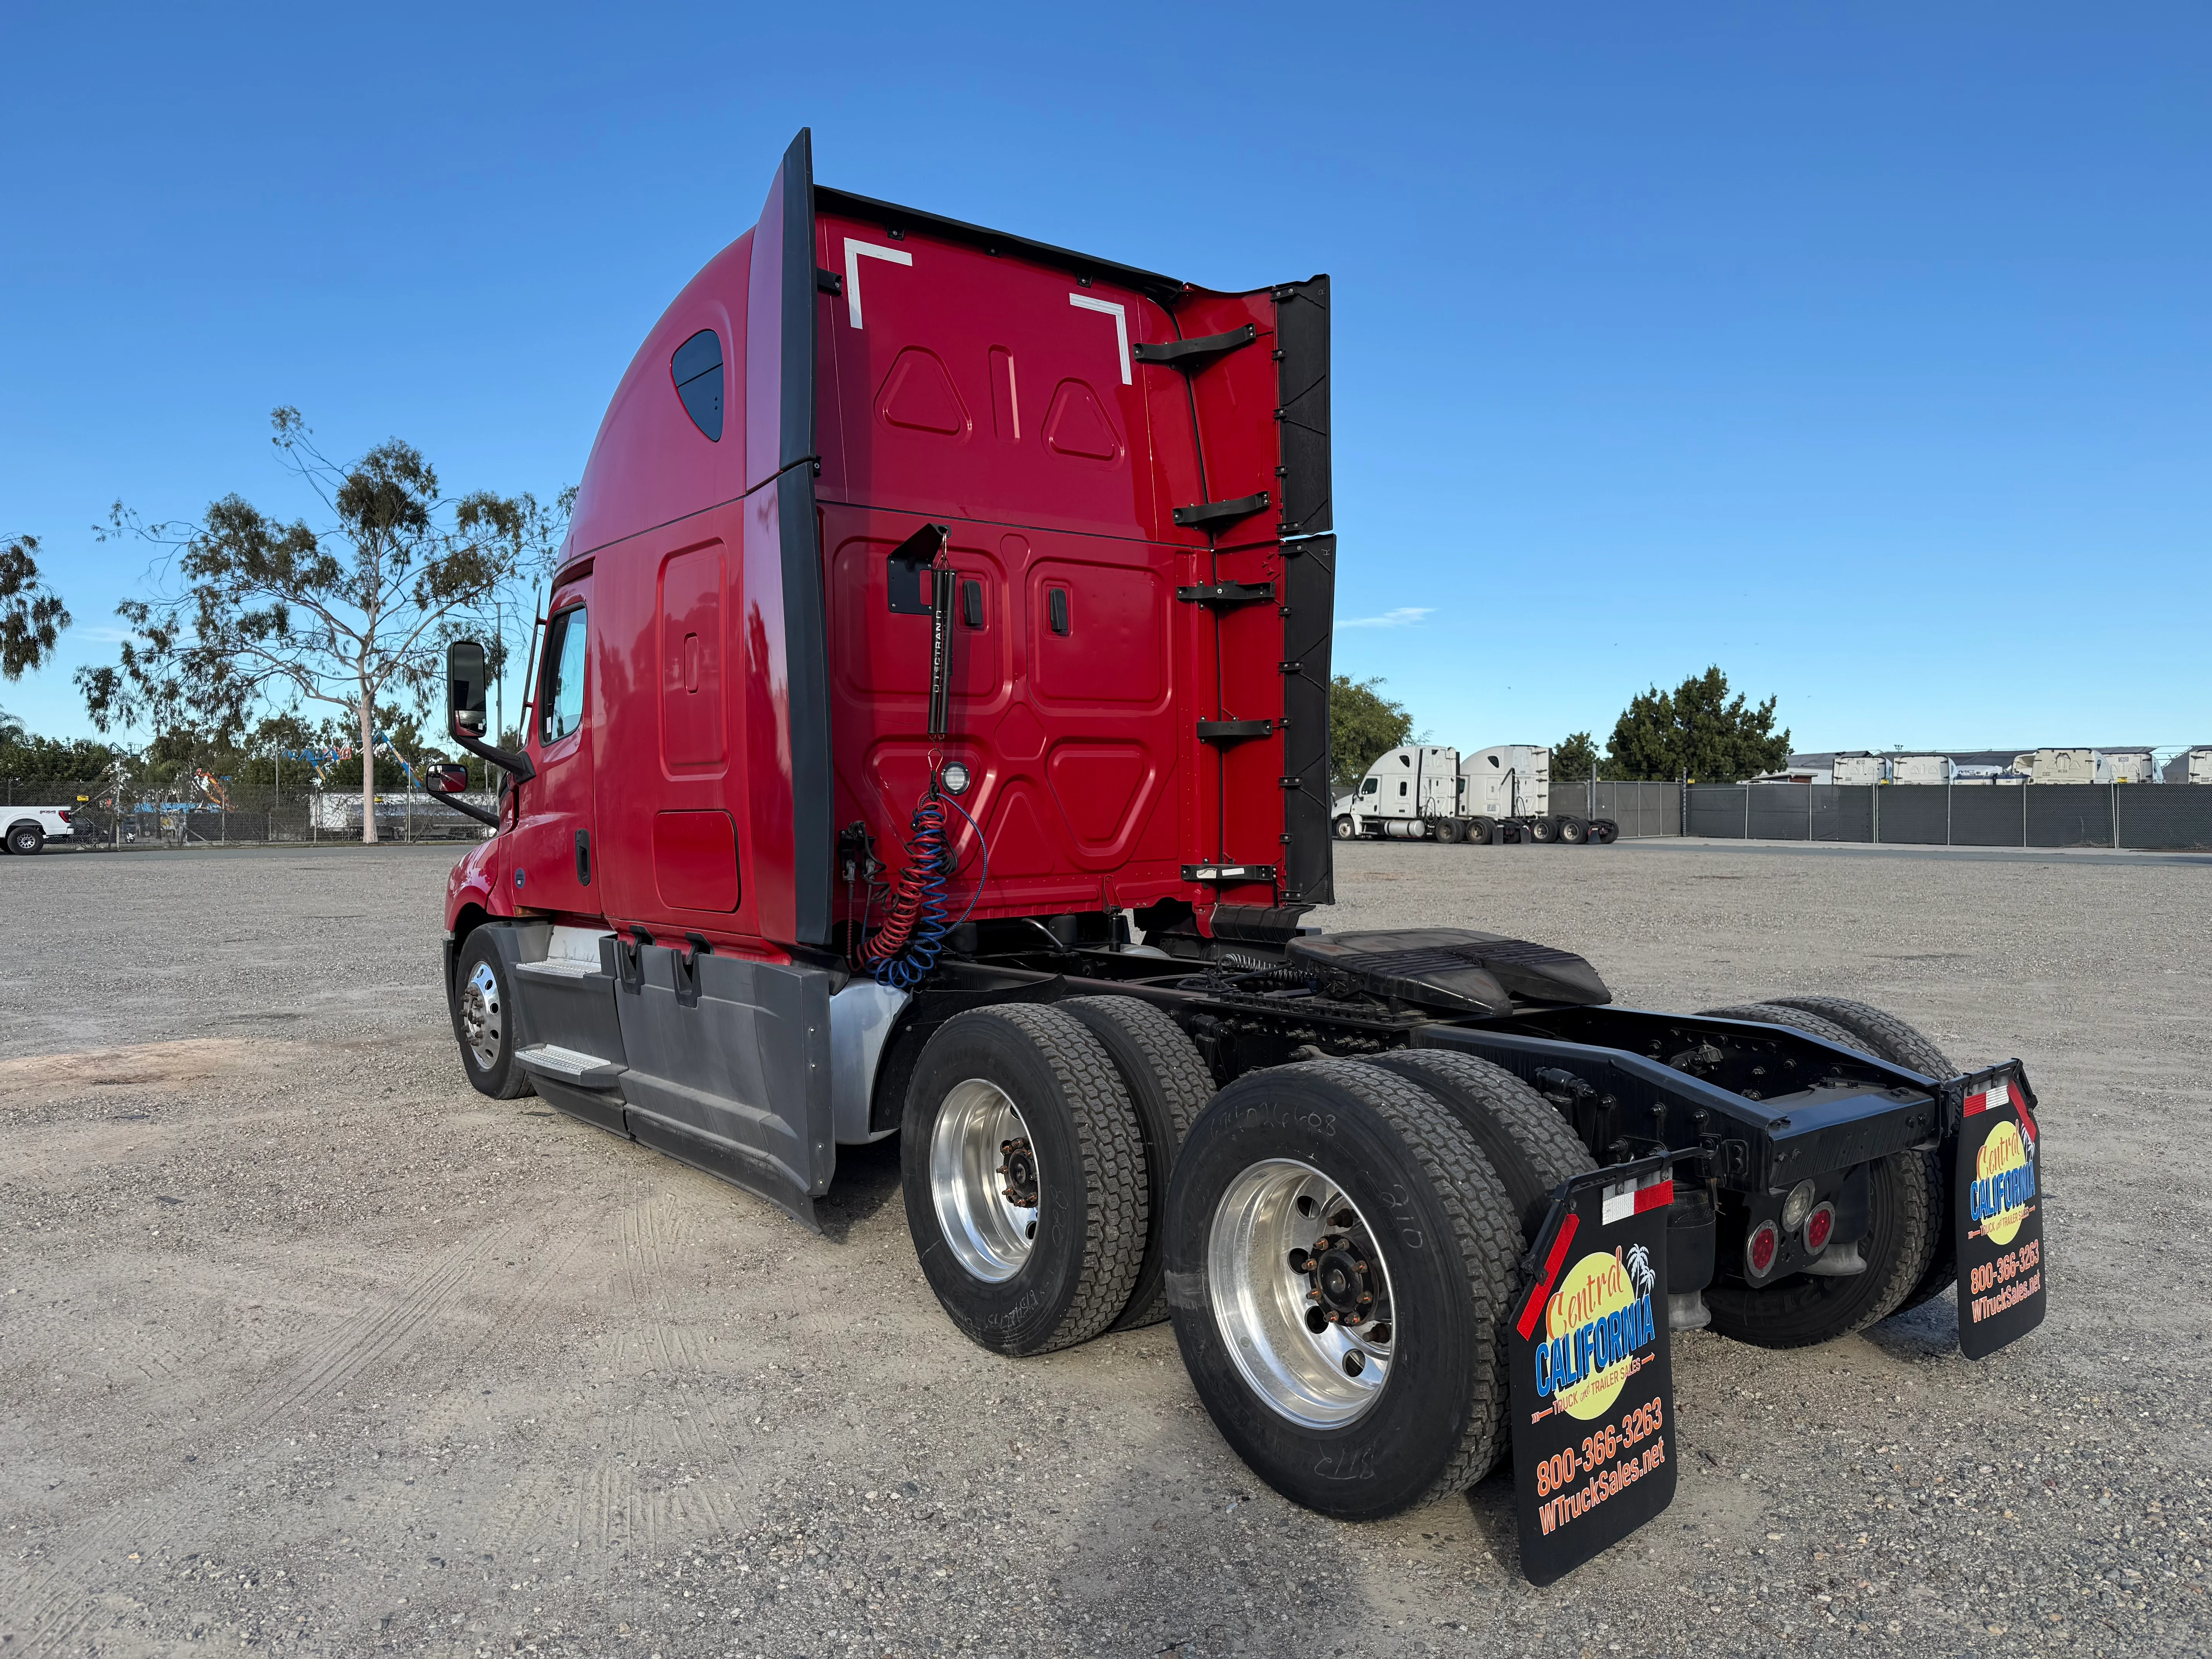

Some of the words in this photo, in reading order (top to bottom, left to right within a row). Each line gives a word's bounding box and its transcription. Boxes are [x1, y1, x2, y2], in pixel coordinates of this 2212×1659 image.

[1976, 1118, 2020, 1182] Central
[1970, 1160, 2035, 1221] CALIFORNIA
[1980, 1221, 1995, 1236] TRUCK
[2002, 1211, 2018, 1227] TRAILER
[2018, 1206, 2030, 1222] SALES
[1546, 1245, 1624, 1341] Central
[1971, 1239, 2039, 1295] 800-366-3263
[1972, 1268, 2040, 1323] WTruckSales.net
[1535, 1294, 1656, 1397] CALIFORNIA
[1553, 1390, 1578, 1415] TRUCK
[1580, 1381, 1590, 1402] and
[1591, 1370, 1619, 1395] TRAILER
[1620, 1357, 1641, 1380] SALES
[1537, 1396, 1663, 1497] 800-366-3263
[1539, 1436, 1665, 1536] WTruckSales.net
